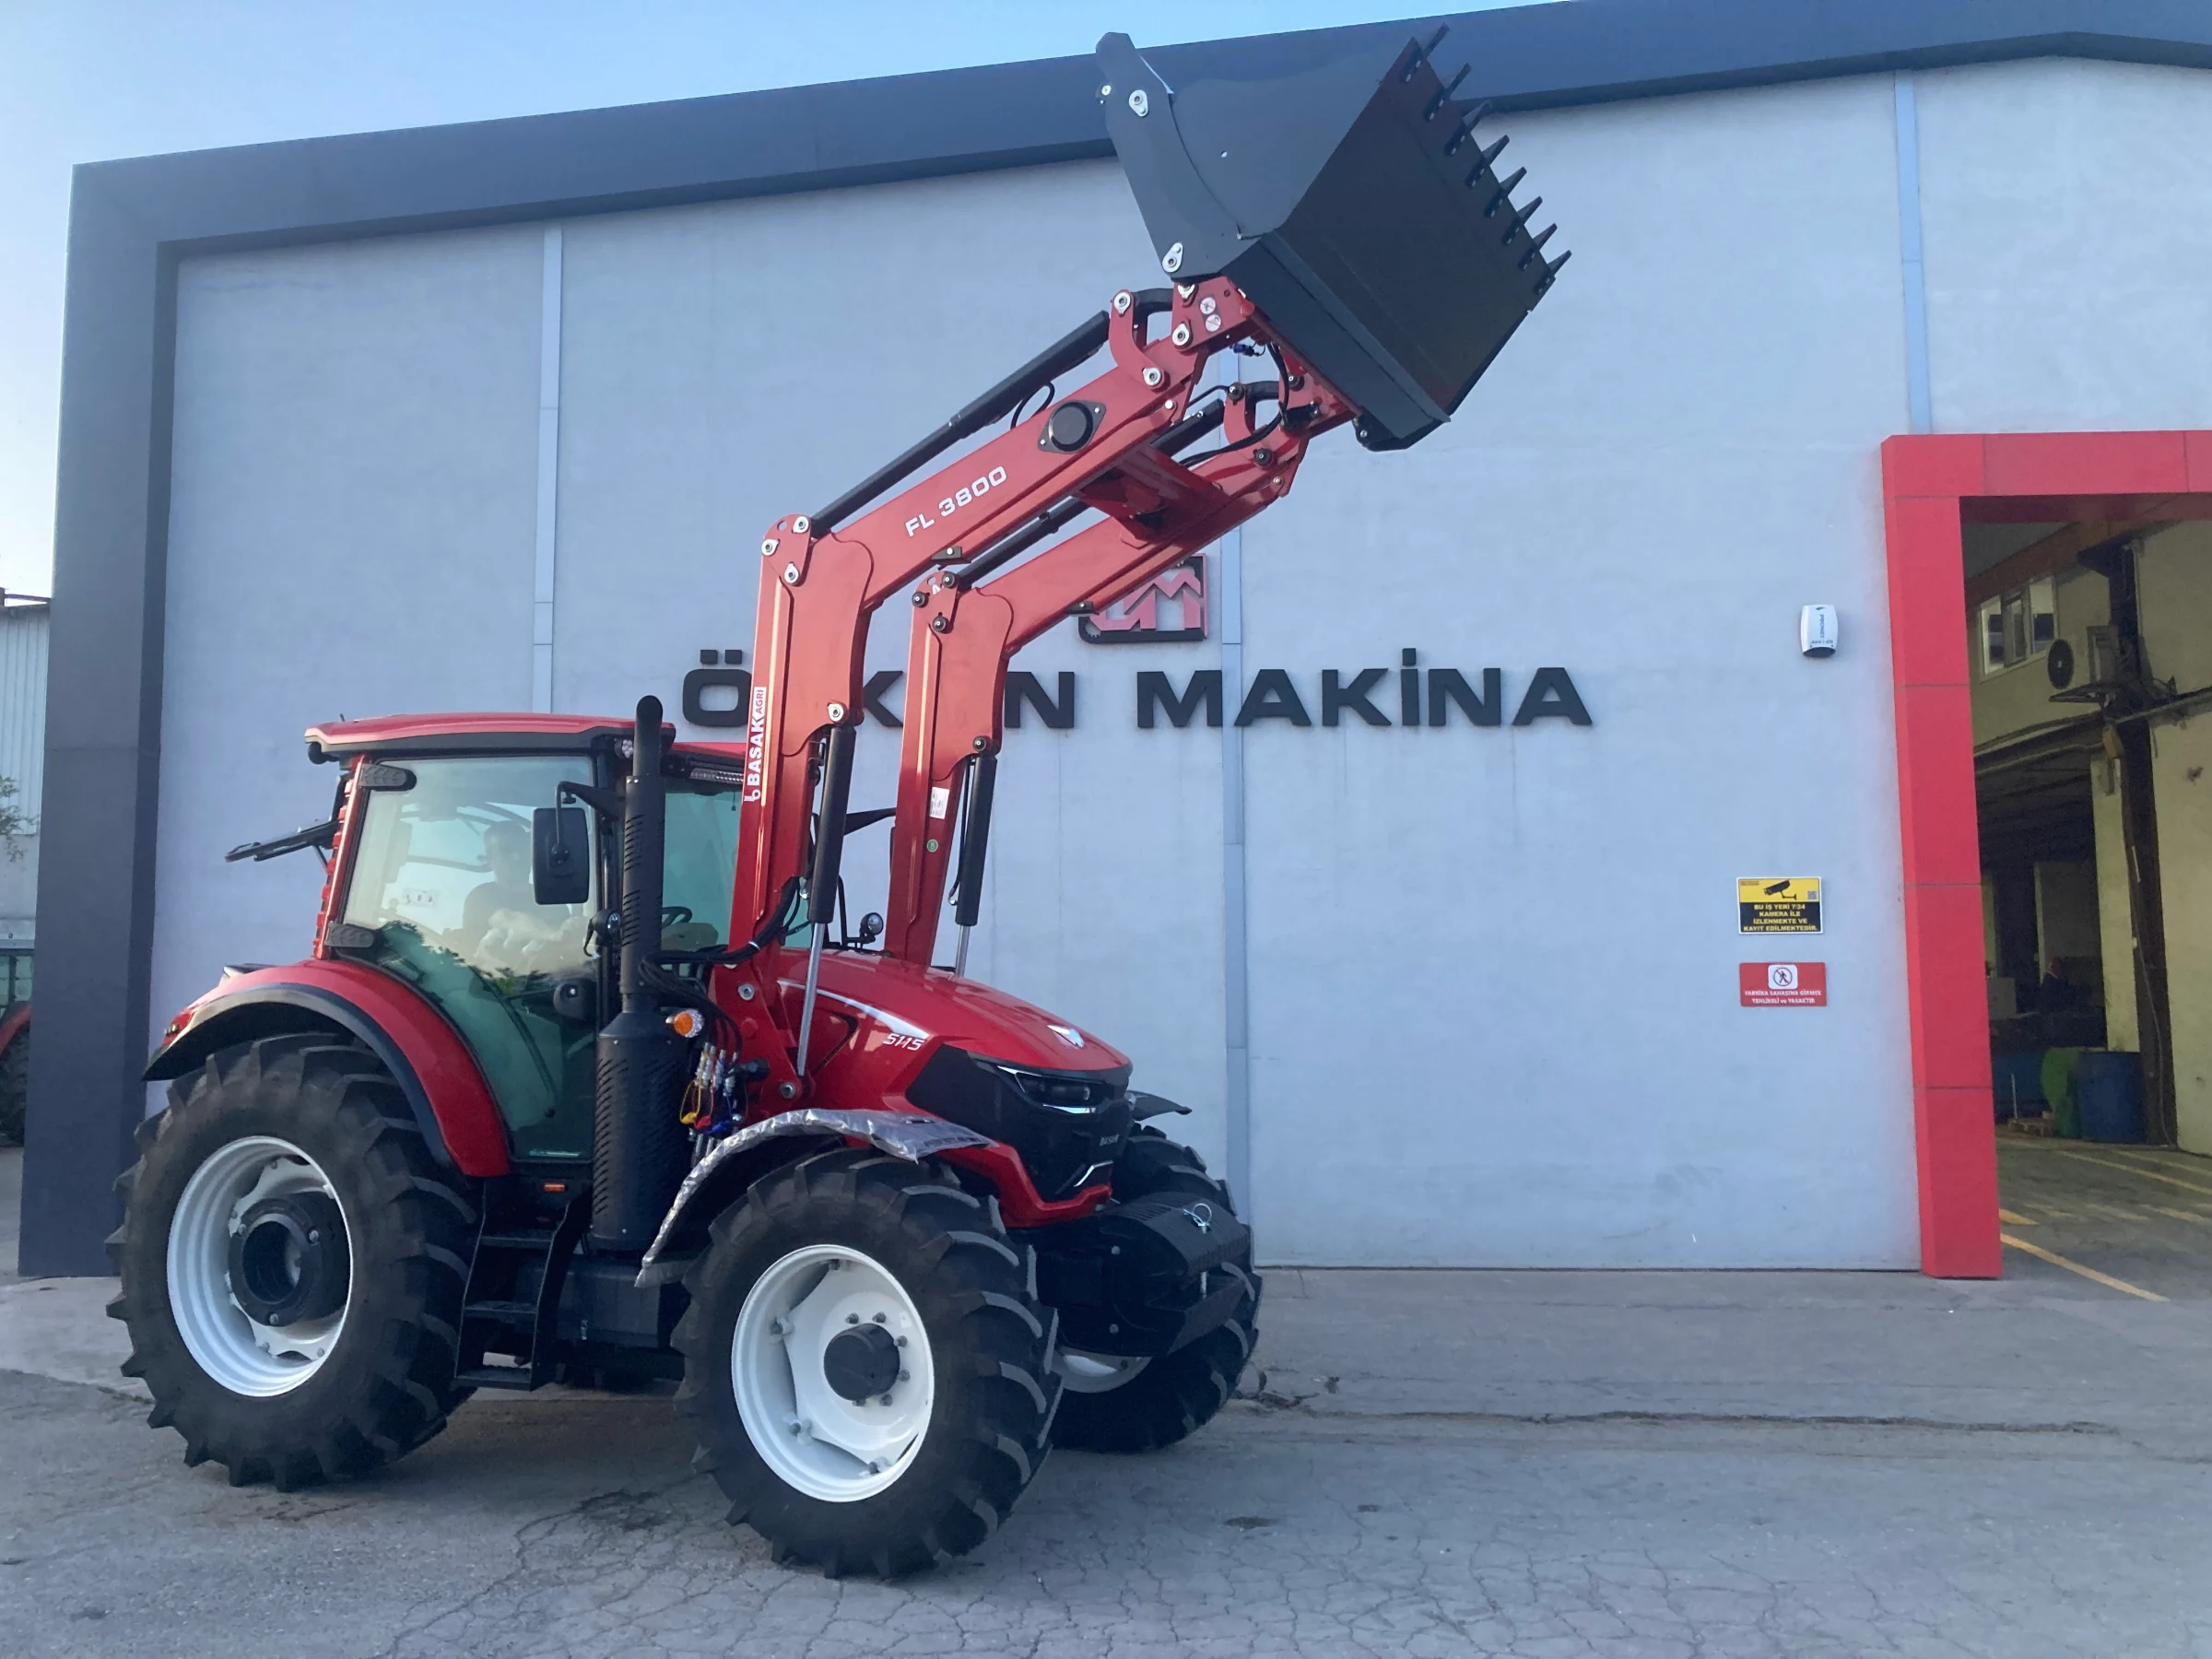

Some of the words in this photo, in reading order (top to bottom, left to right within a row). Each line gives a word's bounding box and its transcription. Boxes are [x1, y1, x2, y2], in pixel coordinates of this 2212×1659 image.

[904, 513, 935, 537] FL
[938, 465, 1007, 517] 3800
[756, 688, 765, 715] AGRI
[1136, 648, 1594, 728] MAKİNA
[882, 1032, 925, 1051] 5115
